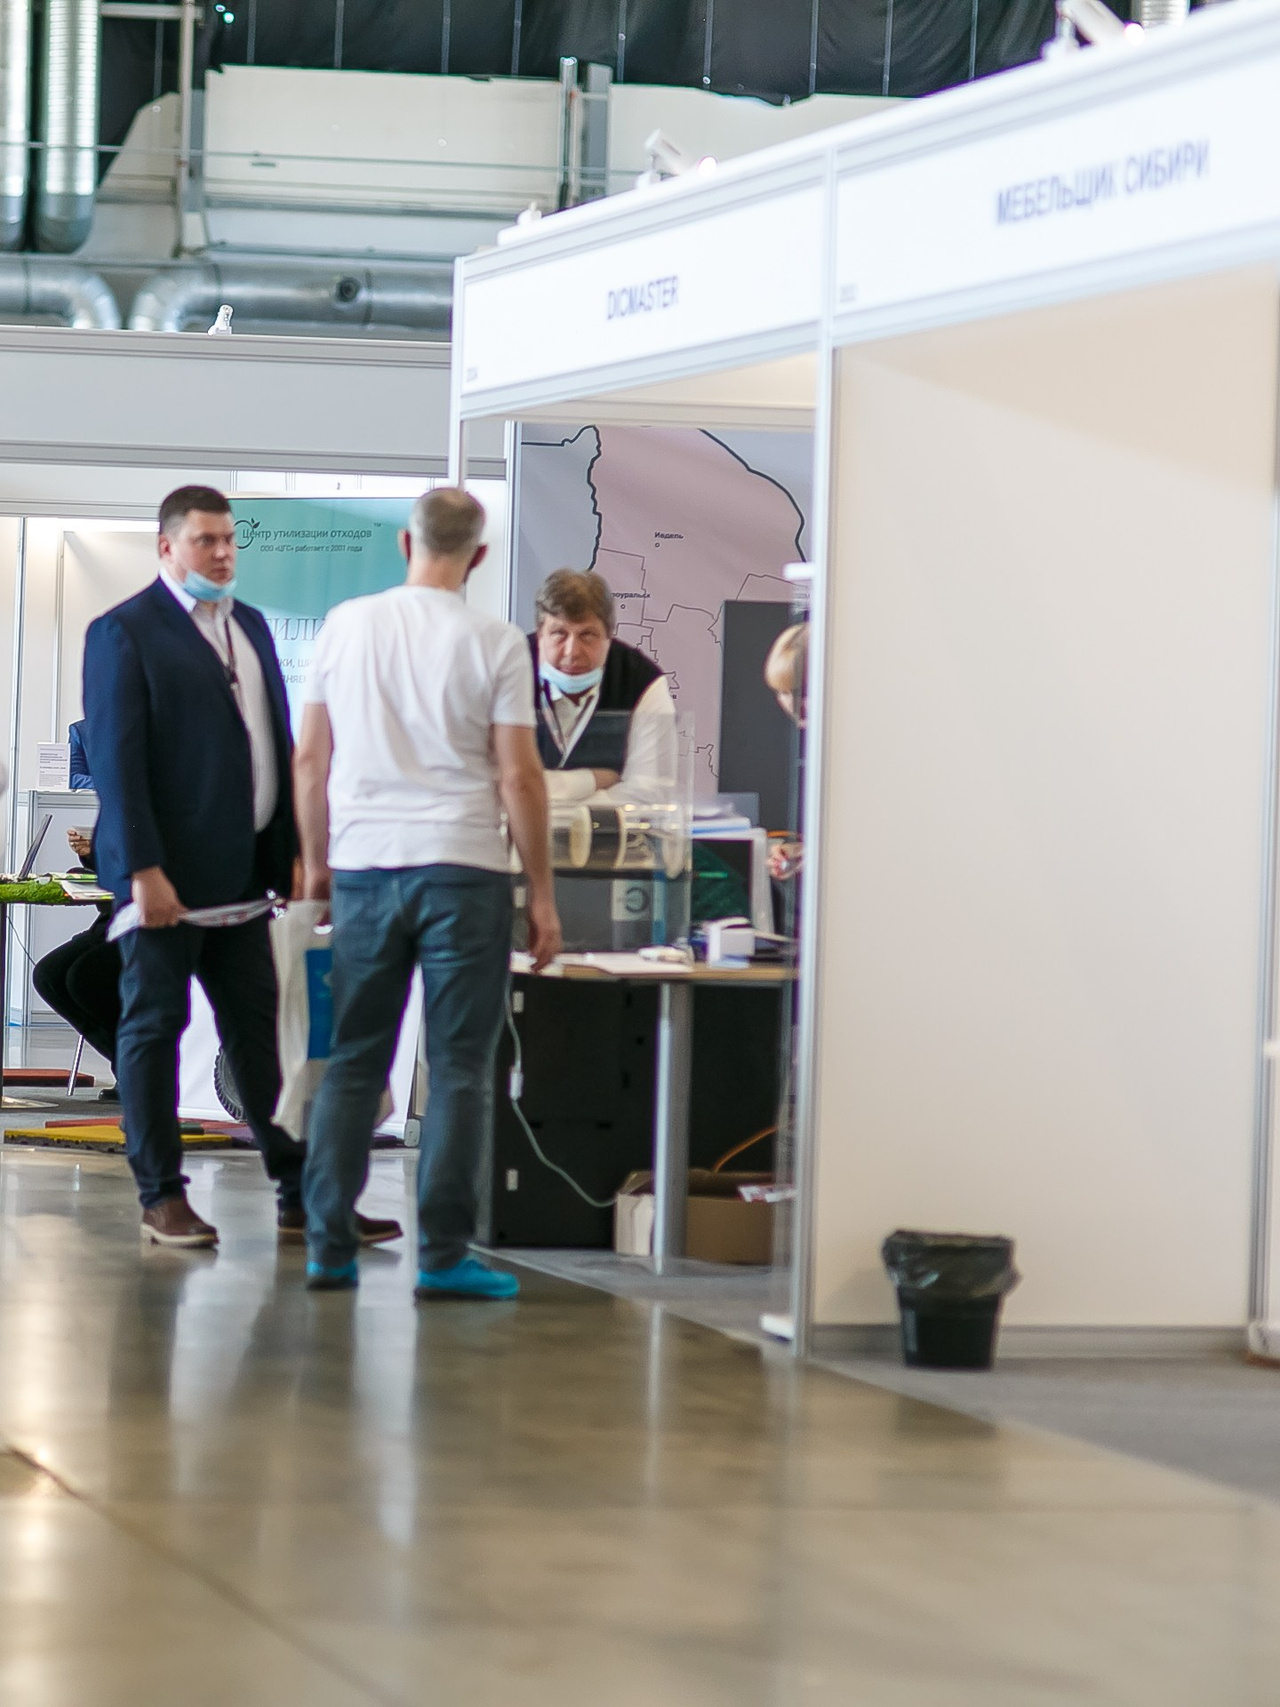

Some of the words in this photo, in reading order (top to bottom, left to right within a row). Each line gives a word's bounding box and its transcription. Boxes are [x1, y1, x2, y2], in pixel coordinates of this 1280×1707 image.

[1124, 138, 1209, 194] СИБИРИ
[242, 529, 271, 541] Центр
[273, 530, 329, 541] утилизации
